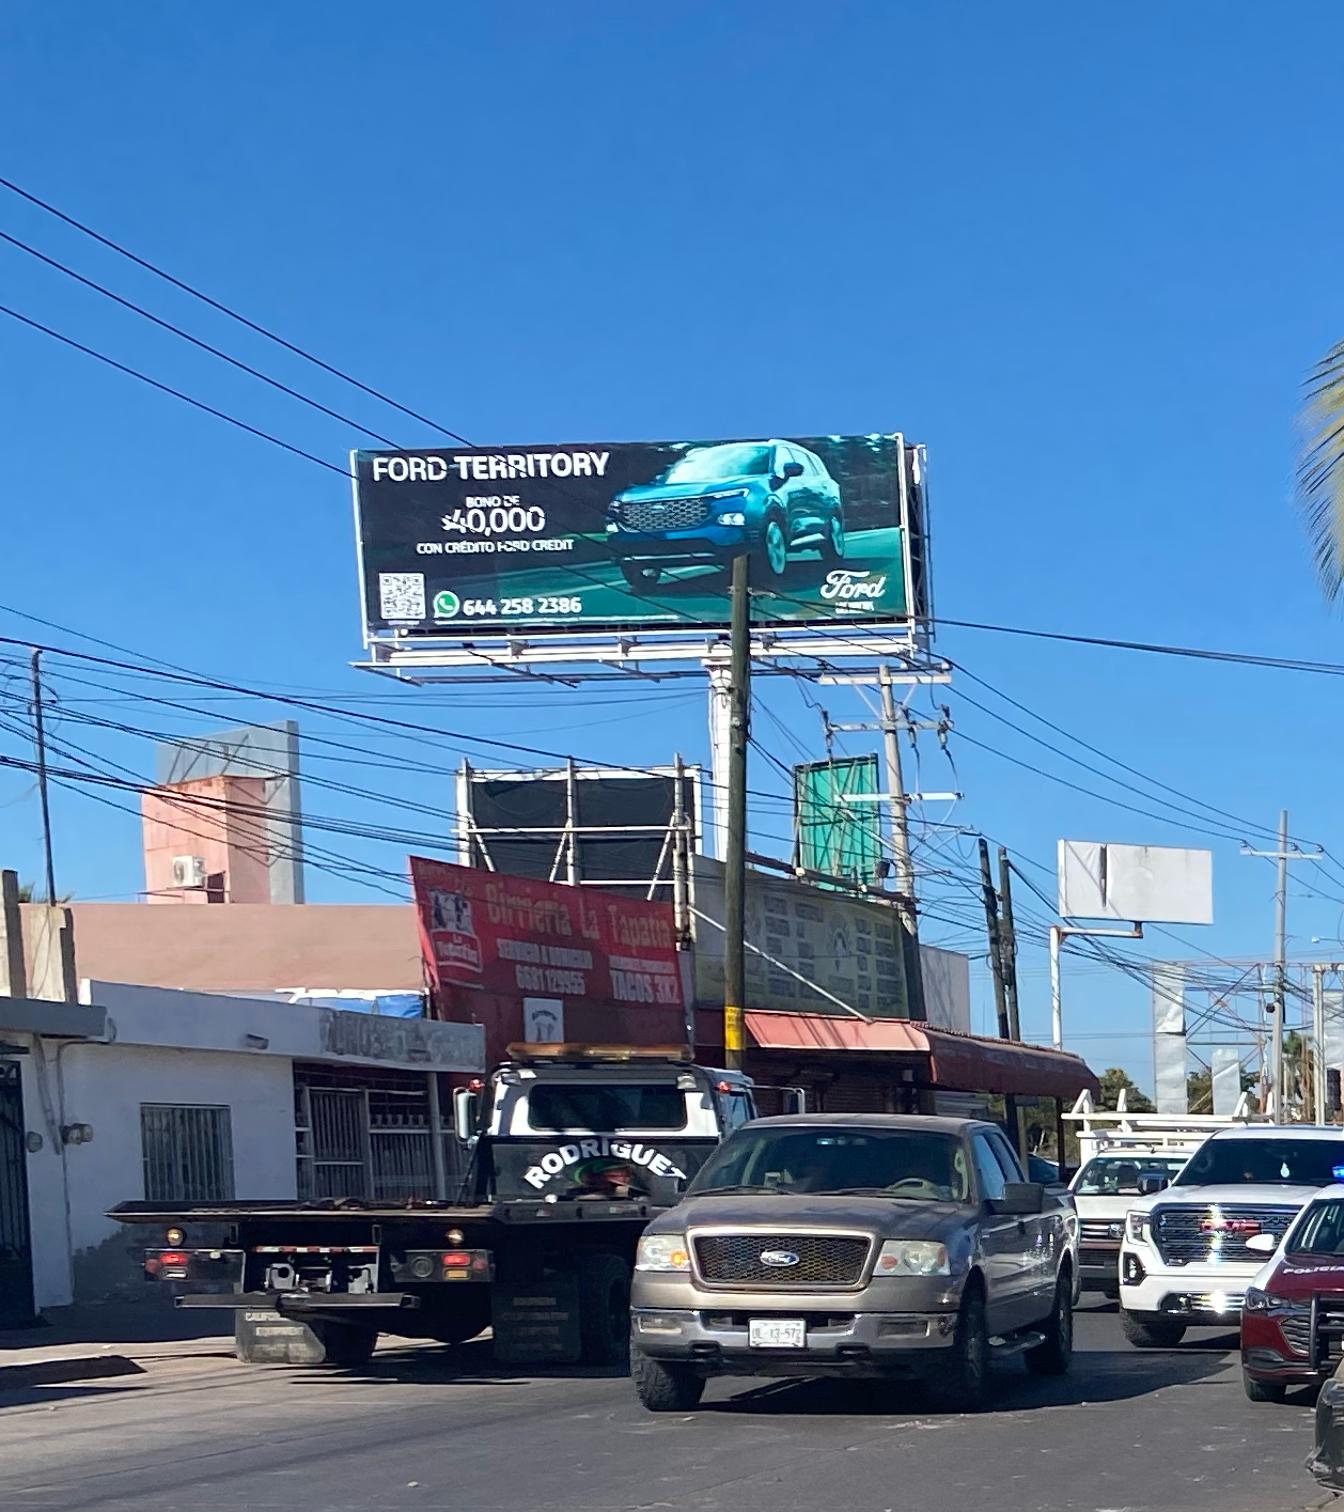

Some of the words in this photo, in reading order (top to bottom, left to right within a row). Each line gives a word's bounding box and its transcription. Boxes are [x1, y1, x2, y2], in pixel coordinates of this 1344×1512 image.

[373, 457, 447, 481] FORD
[453, 452, 610, 480] TERRITORY
[466, 497, 501, 508] BONO
[503, 496, 520, 507] DE
[441, 506, 546, 536] $40,000
[416, 543, 443, 554] CON
[497, 540, 529, 552] FORD
[531, 539, 575, 551] CREDIT
[820, 570, 887, 598] Ford
[463, 598, 498, 616] 644
[501, 598, 535, 614] 258
[538, 597, 583, 613] 2386
[609, 970, 653, 1003] TACOS
